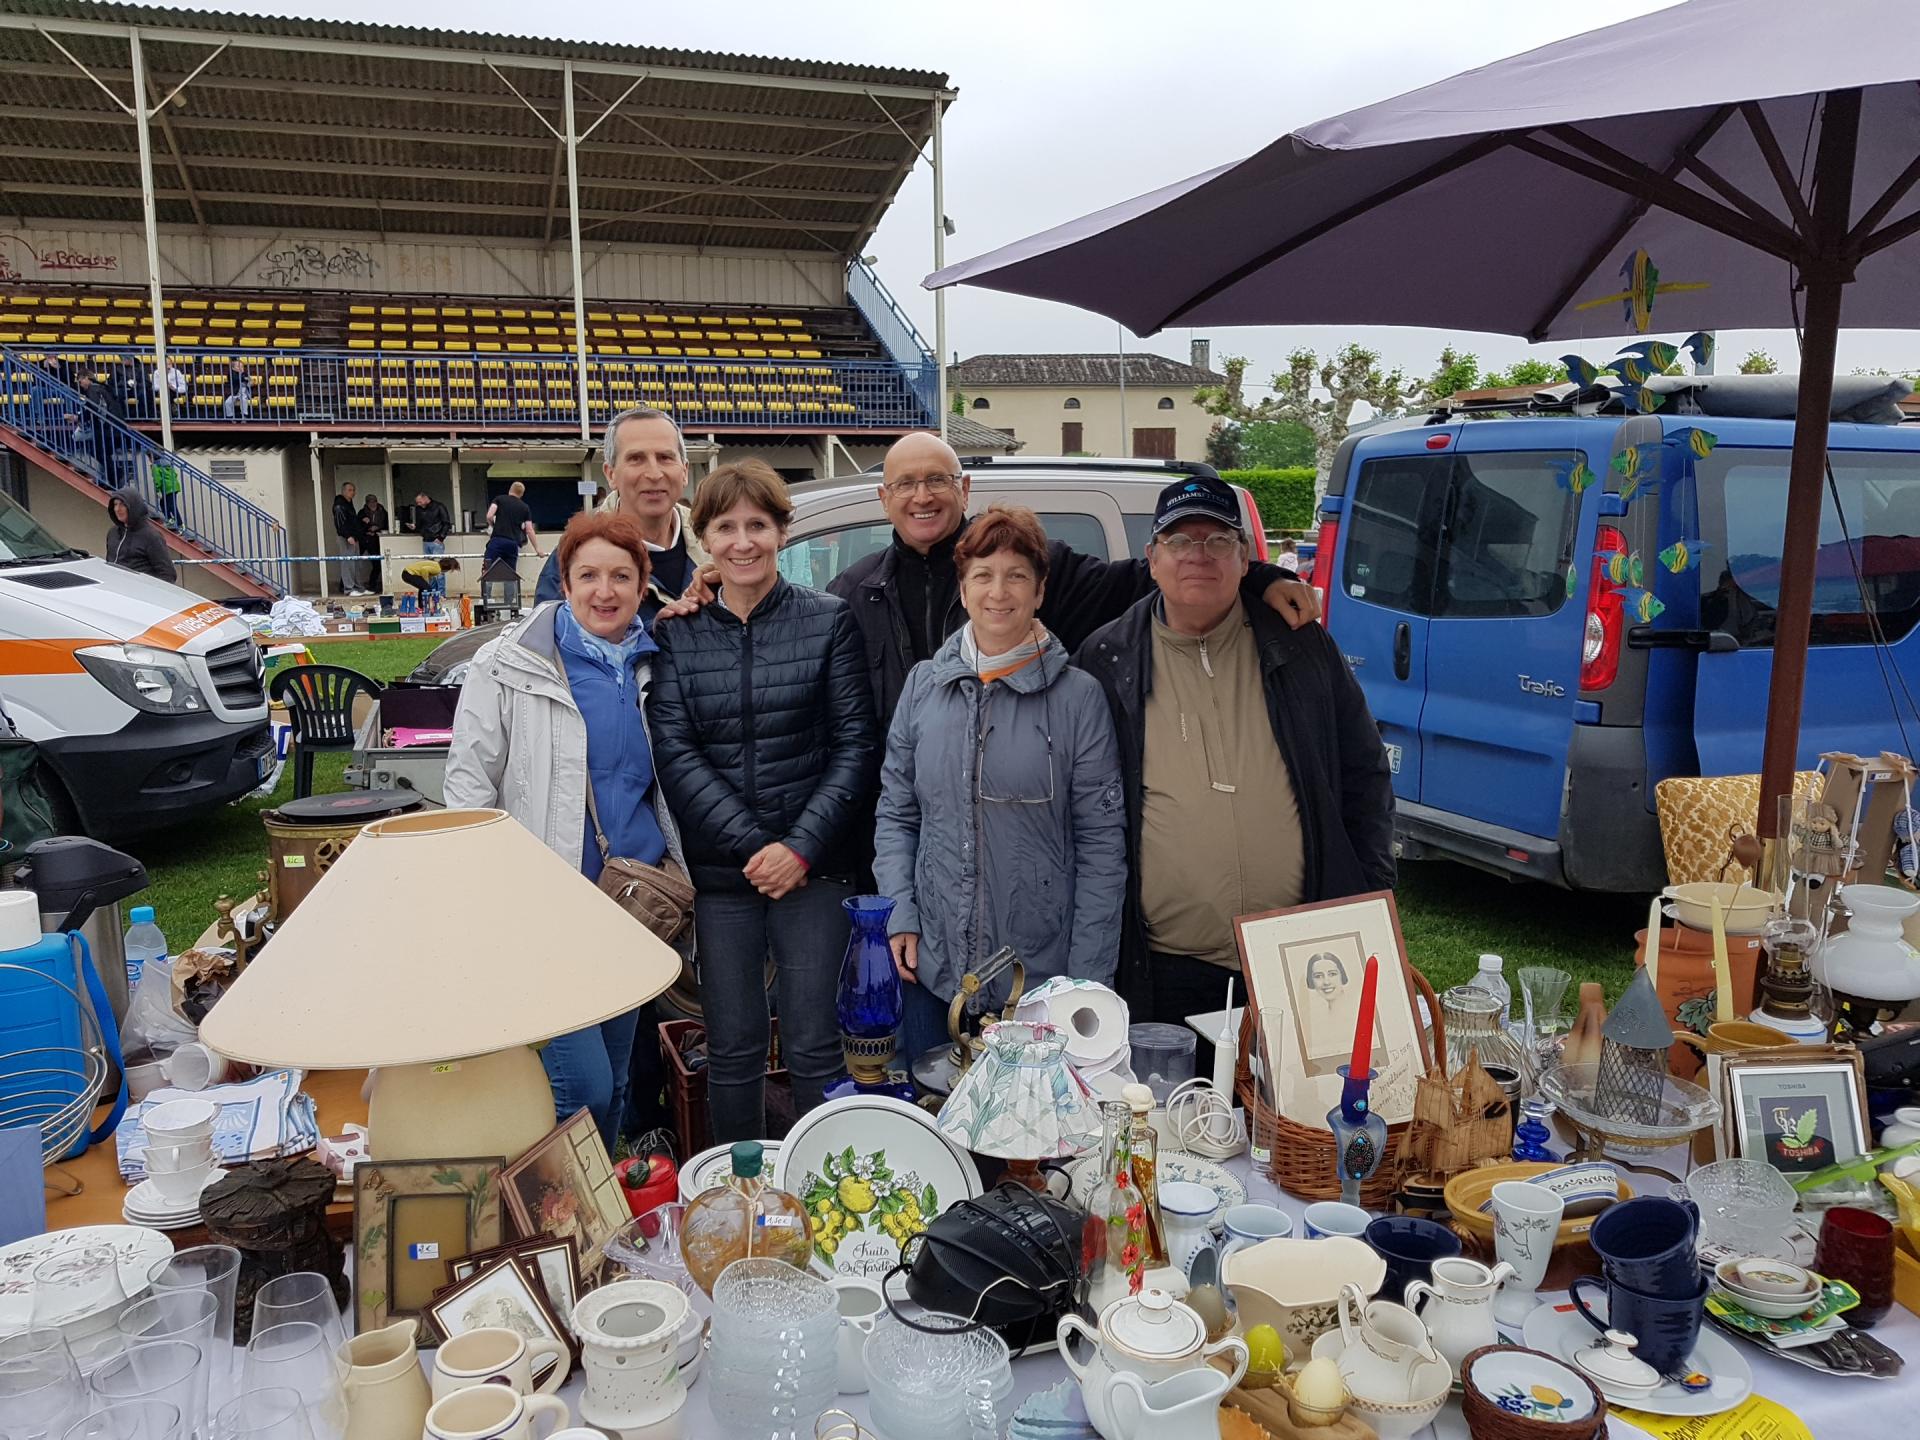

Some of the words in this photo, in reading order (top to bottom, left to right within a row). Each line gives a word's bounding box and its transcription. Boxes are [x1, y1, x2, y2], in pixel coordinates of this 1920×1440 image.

[1518, 674, 1566, 697] Trafic
[1783, 1146, 1820, 1159] TOSHIBA
[853, 1240, 889, 1258] Fruits
